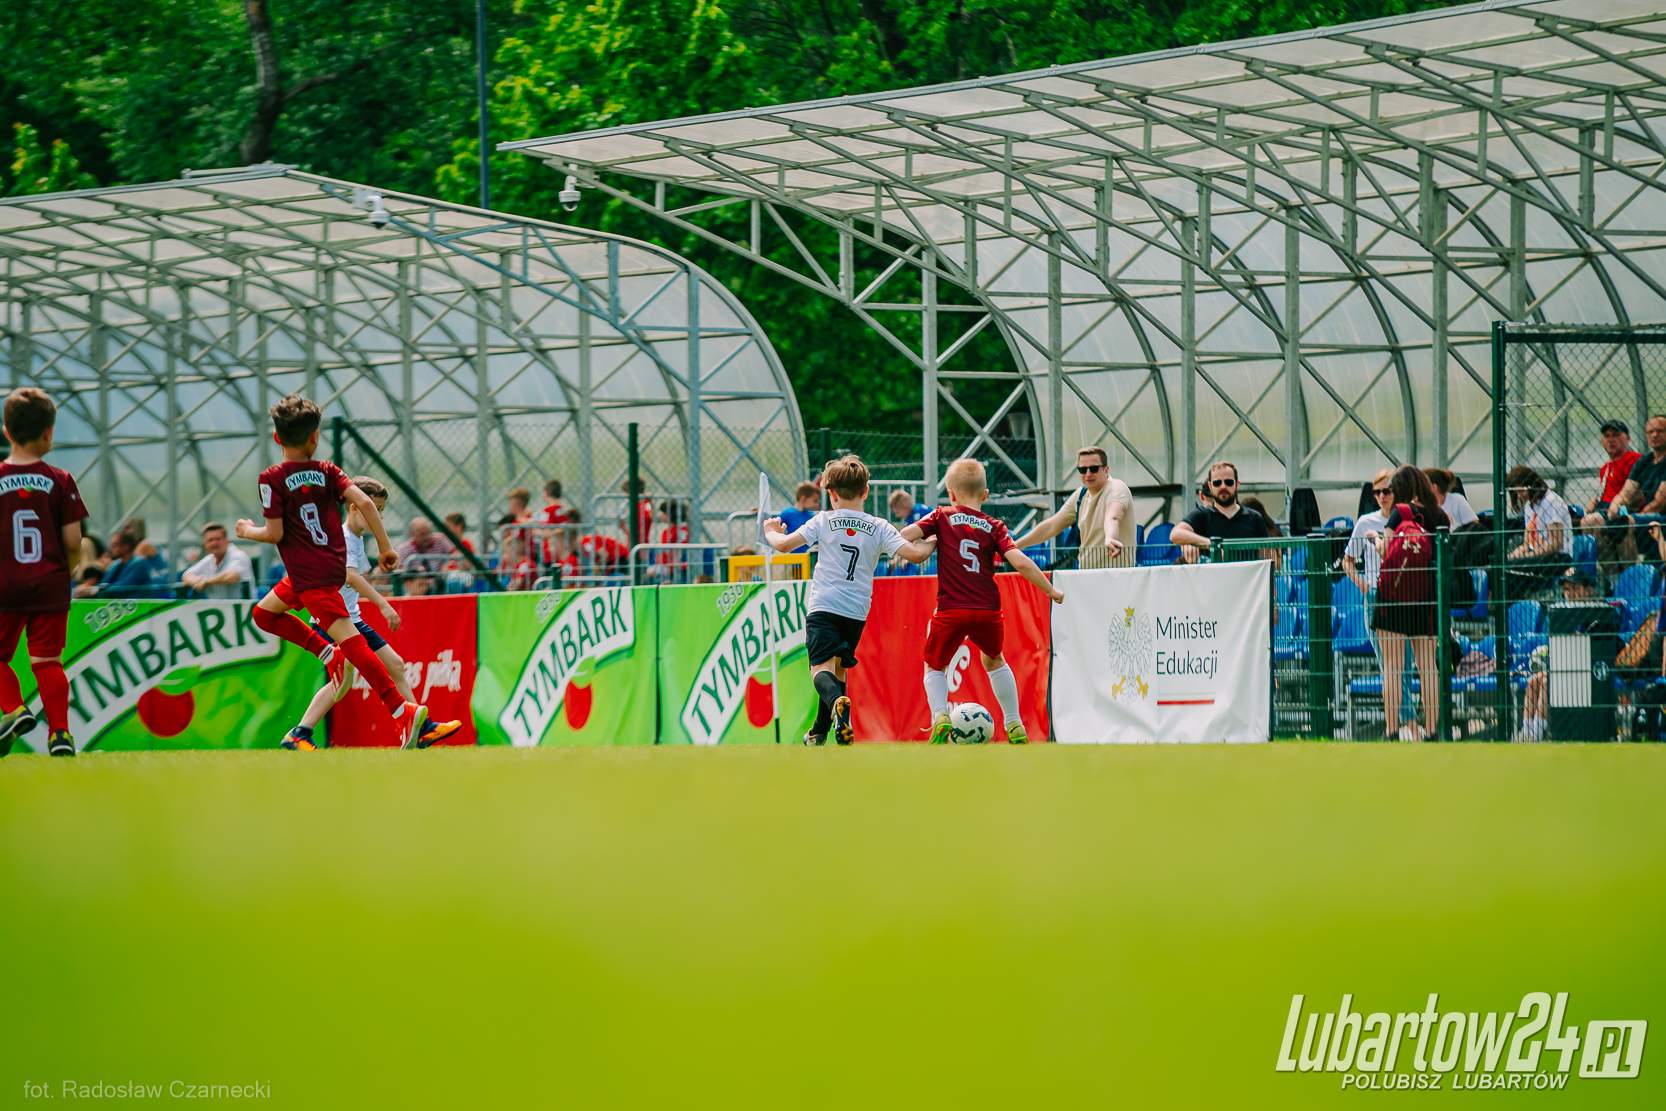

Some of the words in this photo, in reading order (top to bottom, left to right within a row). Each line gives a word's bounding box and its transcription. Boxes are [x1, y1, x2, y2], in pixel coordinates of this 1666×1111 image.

[12, 509, 43, 564] 6
[300, 502, 329, 546] 8
[833, 519, 873, 533] TYMBARK
[840, 543, 860, 582] 7
[958, 538, 981, 574] 5
[1156, 616, 1218, 640] Minister
[36, 602, 267, 724] YMBARK
[514, 589, 628, 738] TYMBARK
[692, 581, 808, 738] TYMBARK
[1156, 650, 1218, 679] Edukacji
